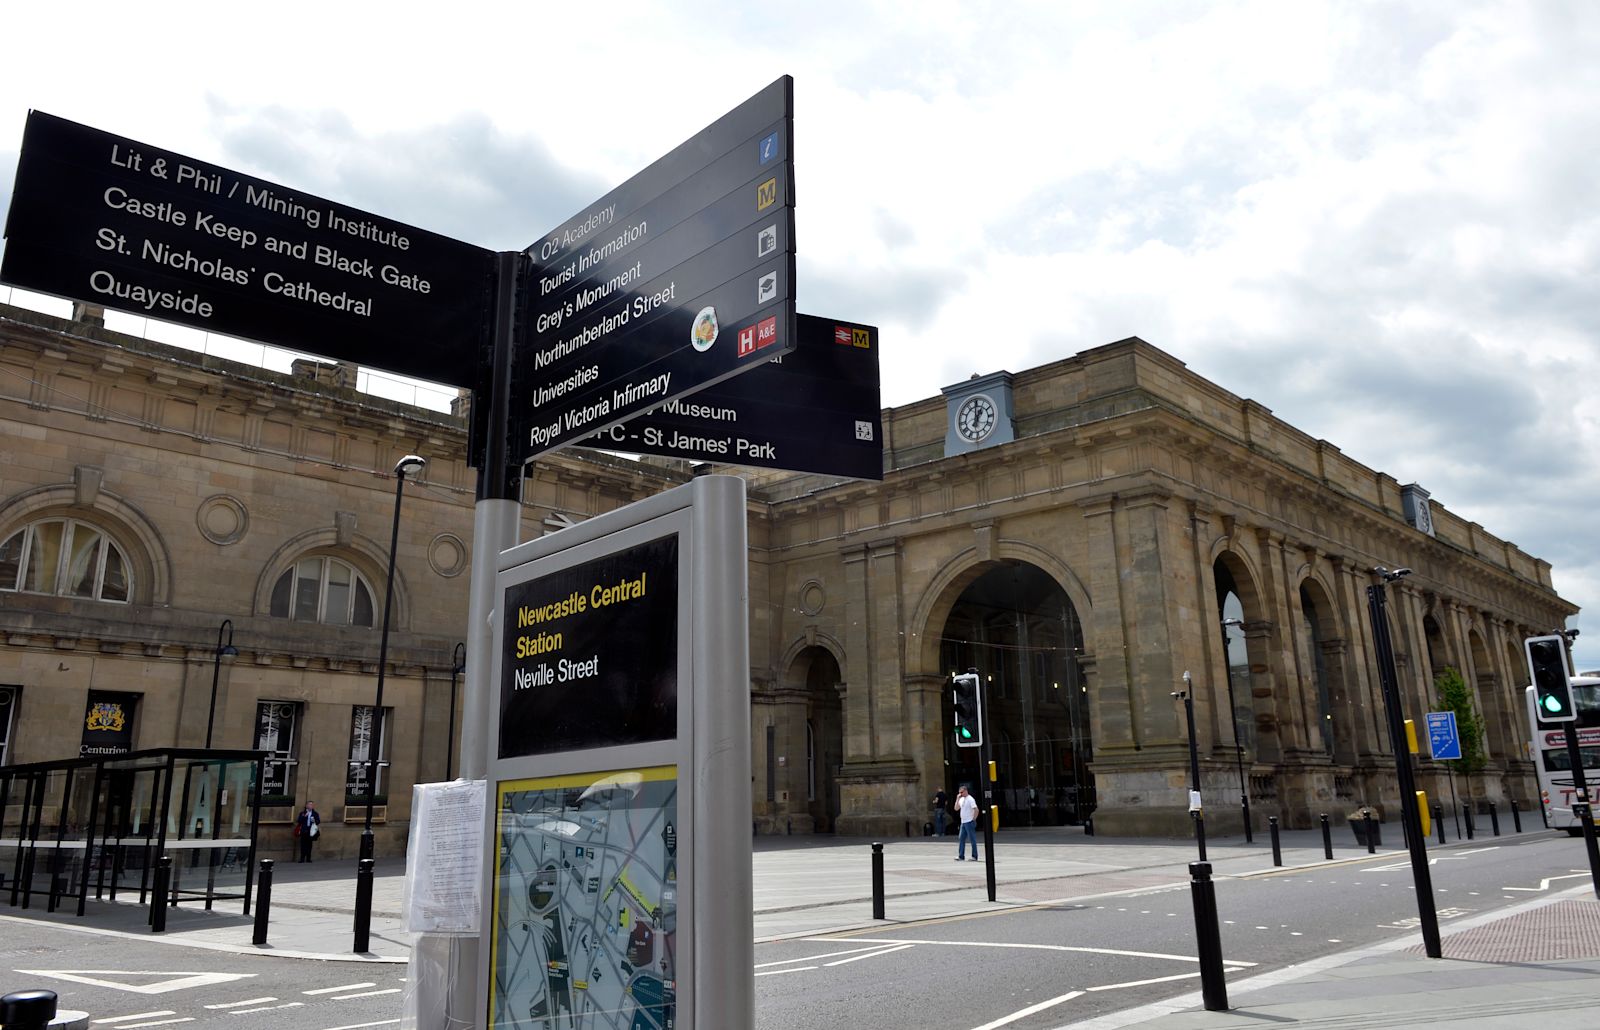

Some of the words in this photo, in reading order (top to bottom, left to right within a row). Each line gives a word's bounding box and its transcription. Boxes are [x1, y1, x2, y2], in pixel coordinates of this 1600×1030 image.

[110, 144, 143, 172] Lit
[150, 158, 168, 180] &
[176, 164, 222, 195] Phil
[228, 181, 240, 198] /
[246, 184, 321, 229] Mining
[328, 210, 410, 251] Institute
[104, 186, 187, 226] Castle
[194, 211, 258, 249] Keep
[264, 236, 308, 260] and
[314, 244, 374, 279] Black
[380, 264, 431, 294] Gate
[561, 203, 617, 249] Academy
[95, 227, 131, 256] St.
[263, 272, 372, 317] Cathedral
[539, 260, 577, 297] Tourist
[578, 221, 648, 274] Information
[90, 270, 213, 318] Quayside
[536, 300, 574, 334] Grey's
[575, 260, 642, 307] Monument
[534, 302, 630, 371] Northumberland
[632, 281, 676, 319] Street
[741, 329, 753, 353] H
[758, 323, 776, 341] A&E
[530, 415, 562, 448] Royal
[564, 396, 611, 432] Victoria
[612, 371, 672, 411] Infirmary
[532, 363, 600, 408] Universities
[662, 398, 737, 422] Museum
[643, 427, 664, 447] St
[667, 430, 732, 454] James'
[736, 438, 776, 460] Park
[518, 591, 587, 629] Newcastle
[590, 572, 646, 609] Central
[516, 631, 562, 659] Station
[514, 662, 554, 691] Neville
[557, 654, 599, 683] Street
[79, 744, 128, 754] Centurion
